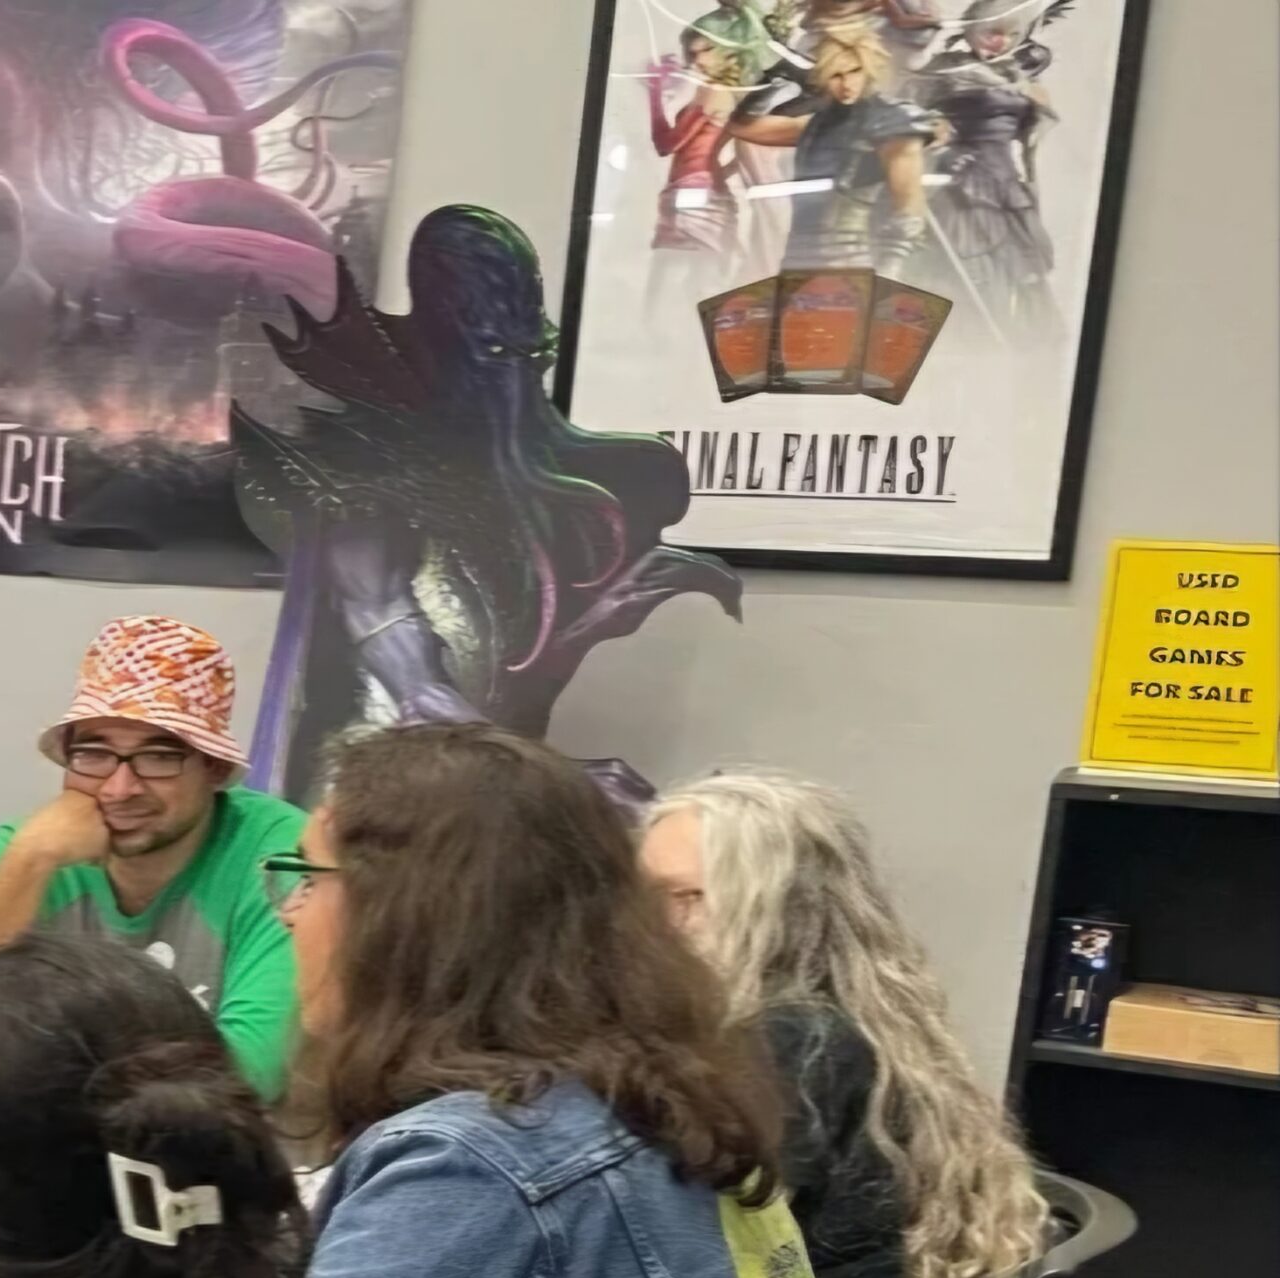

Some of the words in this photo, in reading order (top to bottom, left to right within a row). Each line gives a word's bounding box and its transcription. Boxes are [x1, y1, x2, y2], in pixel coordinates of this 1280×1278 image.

[776, 432, 957, 496] FANTASY
[1176, 572, 1240, 590] USED
[1154, 607, 1251, 628] BOARD
[1148, 646, 1247, 667] GAMES
[1130, 681, 1181, 699] FOR
[1188, 685, 1254, 704] SALE
